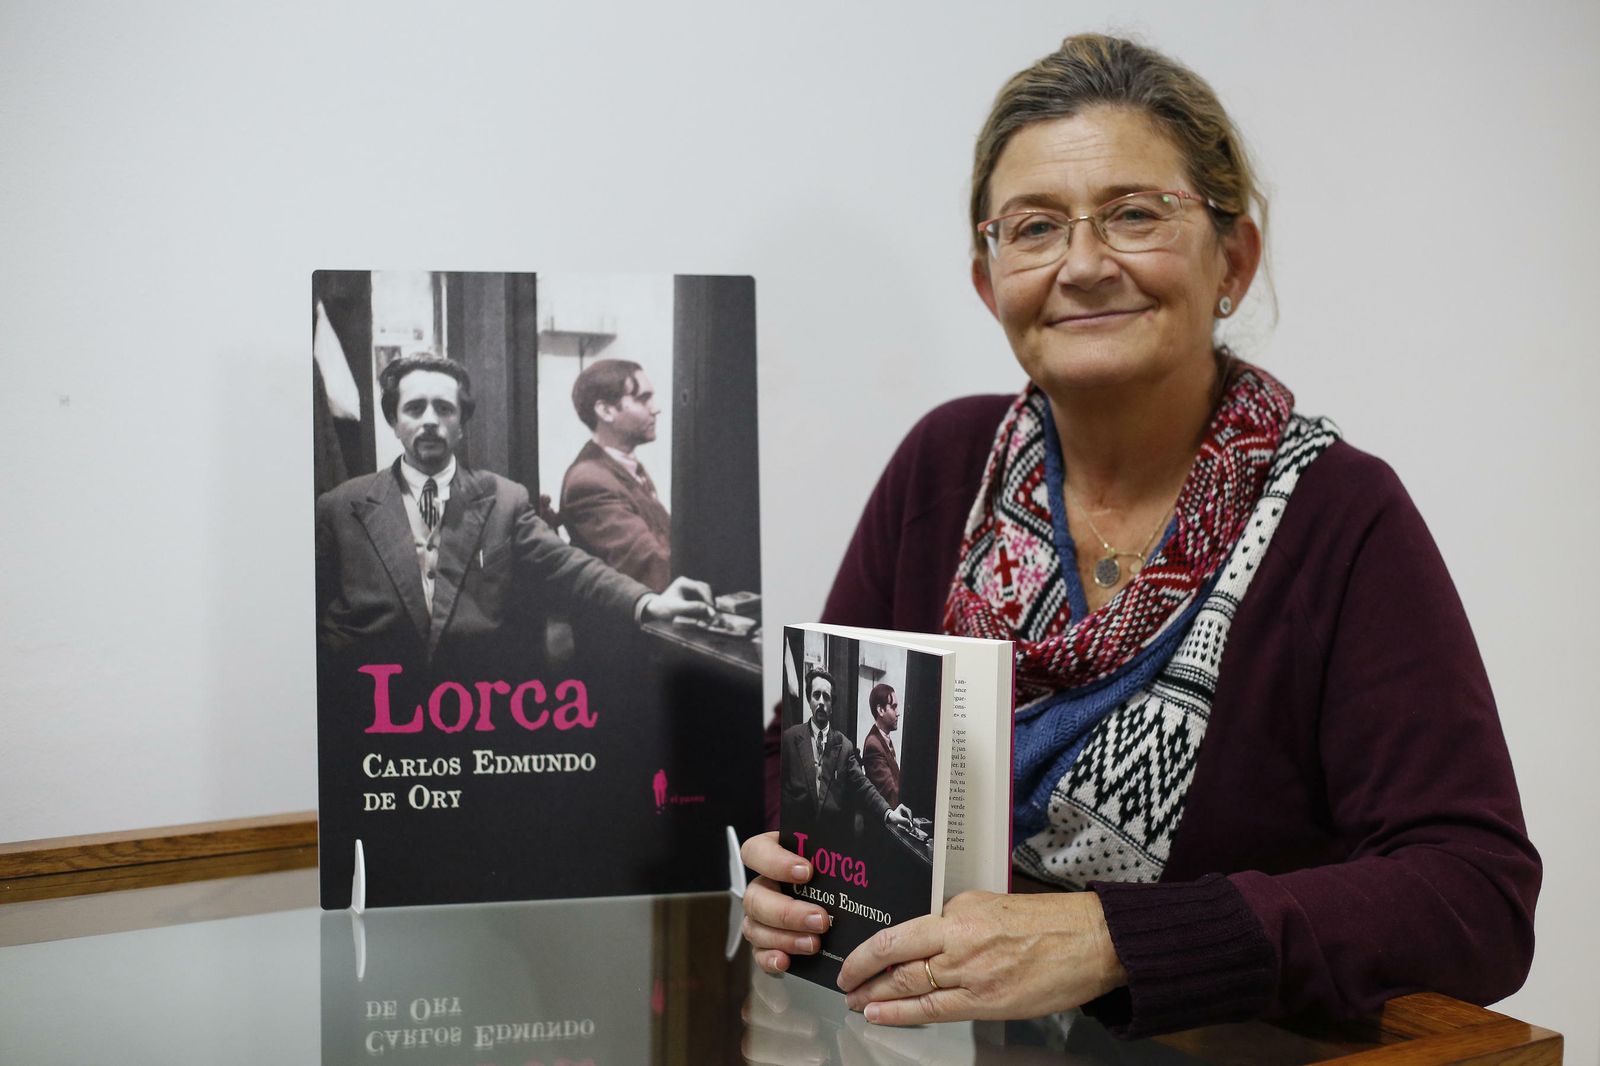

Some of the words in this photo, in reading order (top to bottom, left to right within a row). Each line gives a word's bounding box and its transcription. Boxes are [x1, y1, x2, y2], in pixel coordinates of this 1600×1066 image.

[357, 663, 599, 735] Lorca
[362, 752, 461, 779] CARLOS
[472, 749, 597, 775] EDMUNDO
[363, 792, 395, 811] DE
[408, 785, 462, 809] ORY
[793, 883, 836, 906] CARLOS
[838, 892, 893, 926] EDMUNDO
